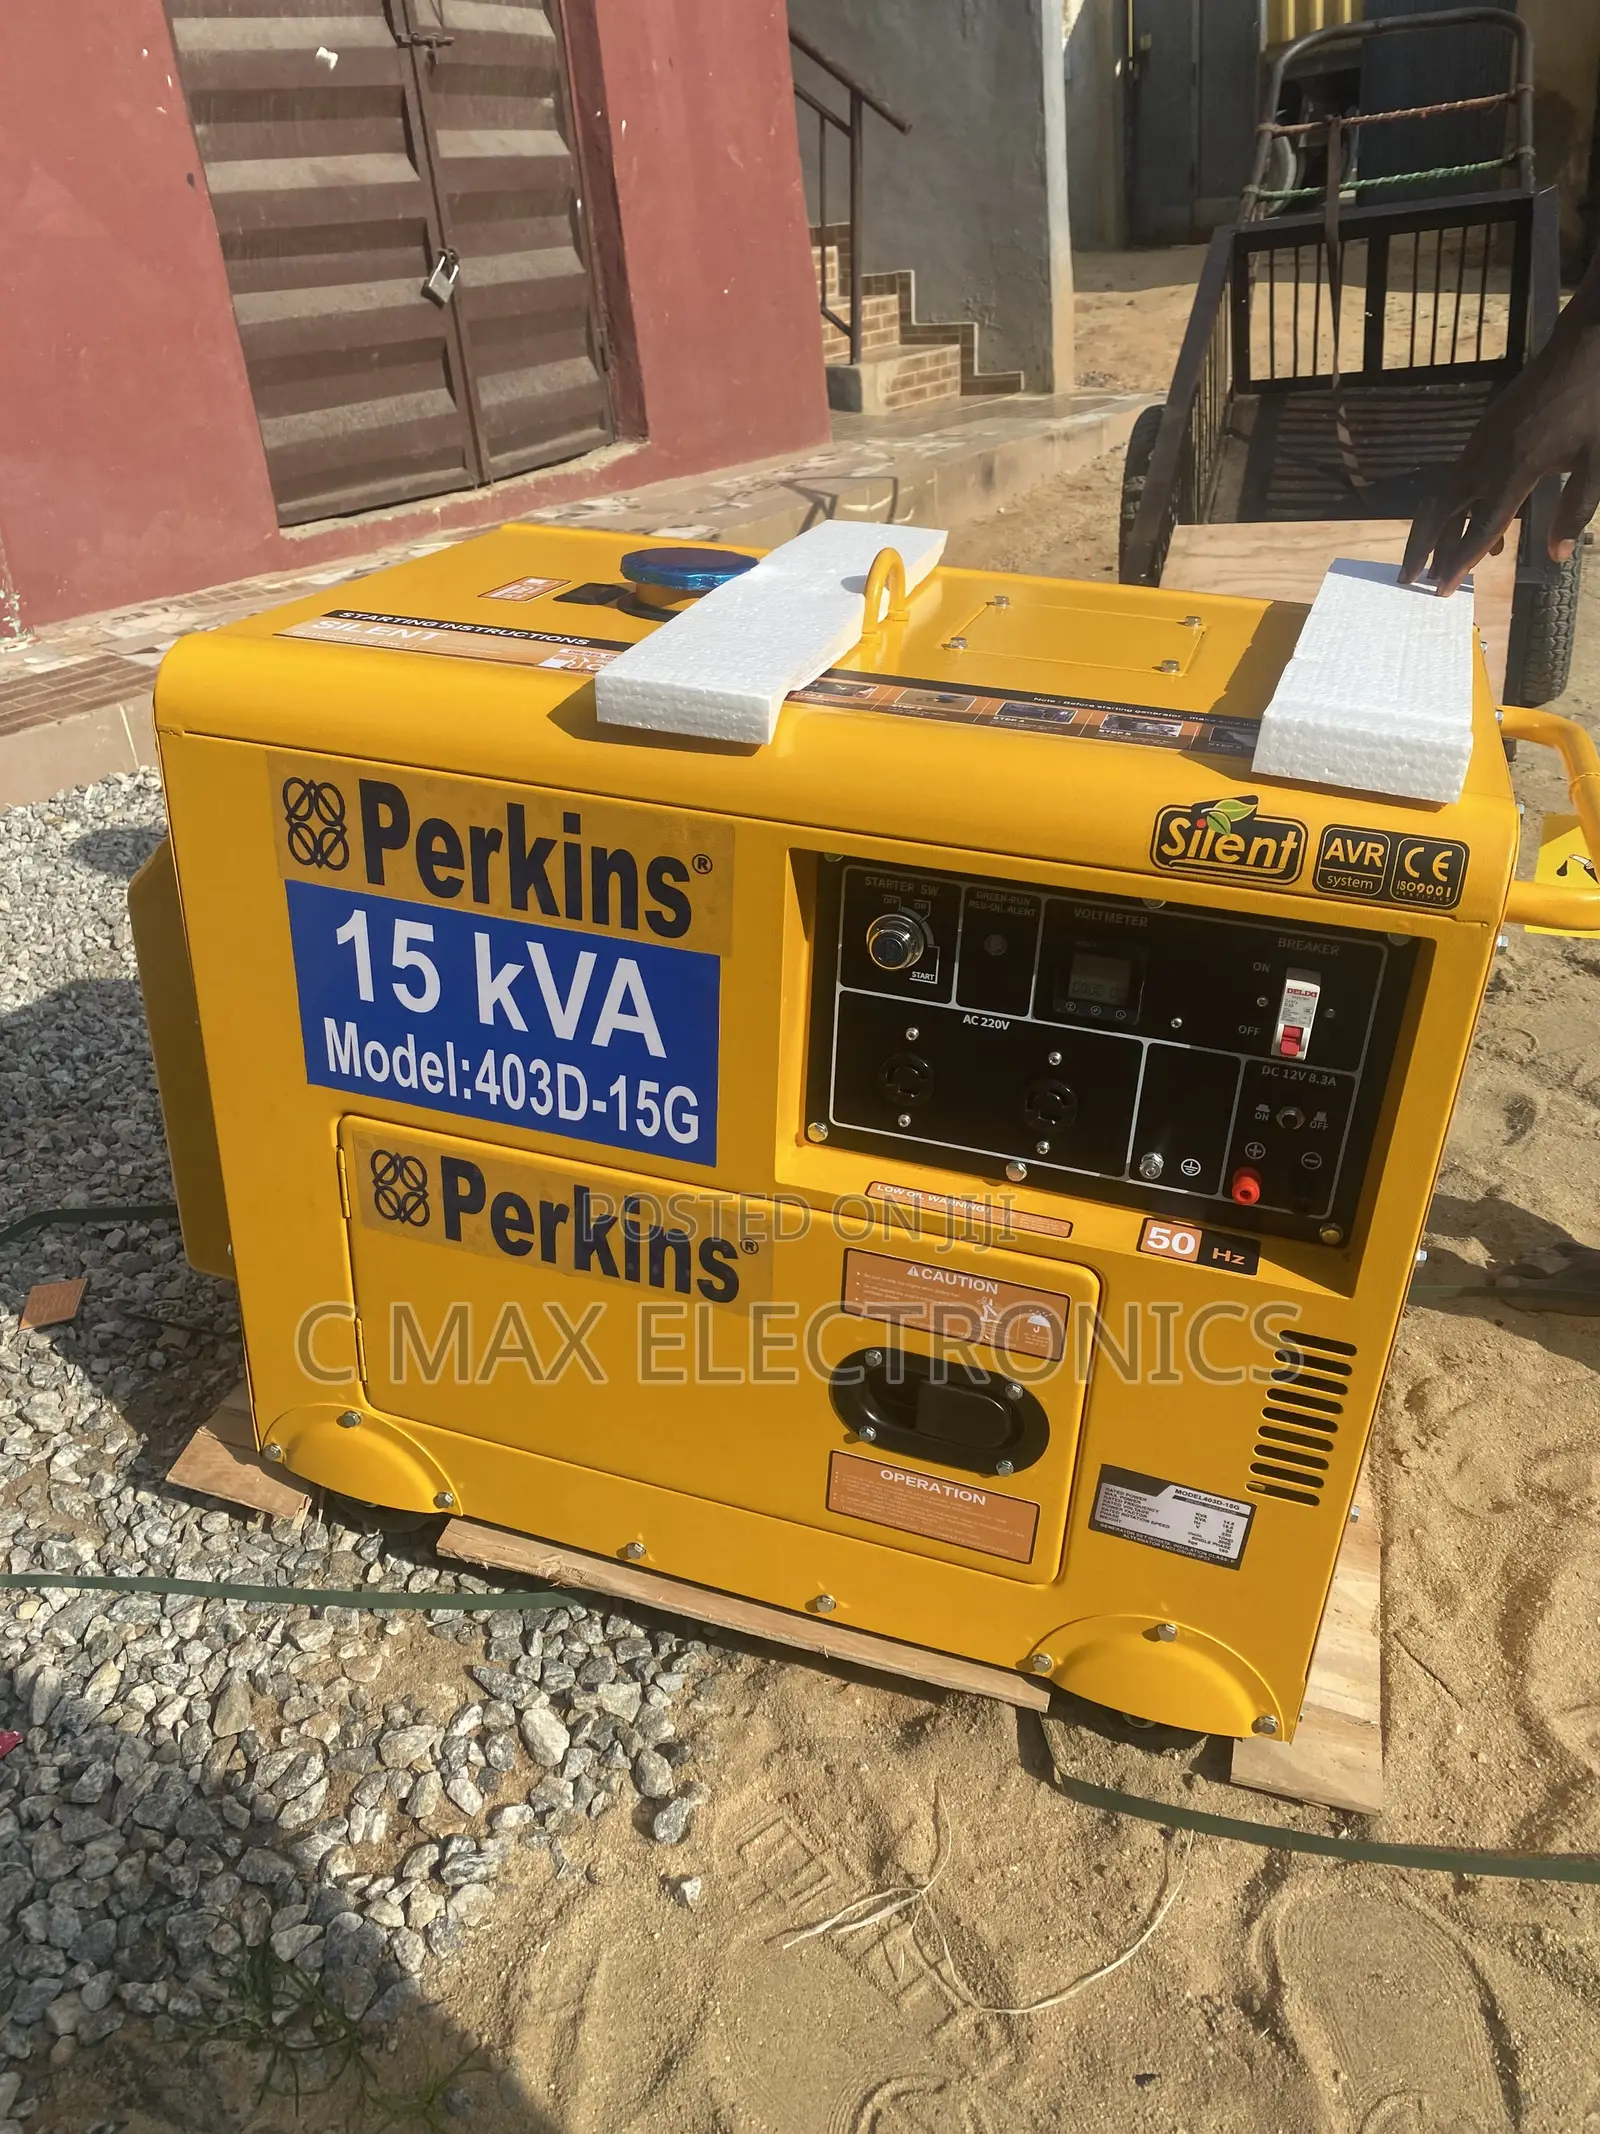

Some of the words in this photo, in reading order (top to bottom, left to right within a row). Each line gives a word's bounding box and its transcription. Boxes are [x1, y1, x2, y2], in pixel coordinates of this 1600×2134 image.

[311, 620, 448, 642] SILENT
[339, 611, 436, 628] STARTING
[440, 621, 591, 646] INSTRUCTIONS
[1160, 812, 1299, 870] Silent
[1324, 836, 1385, 868] AVR
[1403, 846, 1453, 882] CE
[864, 876, 917, 893] STARTER
[1326, 874, 1374, 891] system
[1396, 879, 1452, 898] ISO9001
[1008, 906, 1037, 918] ALERT
[1074, 907, 1149, 928] VOLTMETER
[1277, 937, 1340, 956] BREAKER
[911, 970, 935, 981] START
[1253, 961, 1271, 973] ON
[335, 908, 441, 1013] 15
[473, 931, 668, 1060] kVA
[1286, 987, 1318, 998] DELIXI
[962, 1013, 980, 1026] AC
[981, 1016, 1011, 1031] 220V
[1238, 1024, 1261, 1036] OFF
[323, 1016, 699, 1144] Model:403D-15G
[1261, 1065, 1280, 1078] DC
[1283, 1068, 1306, 1082] 12V
[1308, 1073, 1337, 1087] 8.3A
[1254, 1111, 1270, 1121] ON
[1309, 1119, 1329, 1131] OFF
[876, 1184, 905, 1196] LOW
[906, 1190, 924, 1200] OIL
[1146, 1226, 1196, 1256] 50
[1211, 1247, 1246, 1266] Hz
[921, 1266, 999, 1295] CAUTION
[879, 1469, 987, 1506] OPERATION
